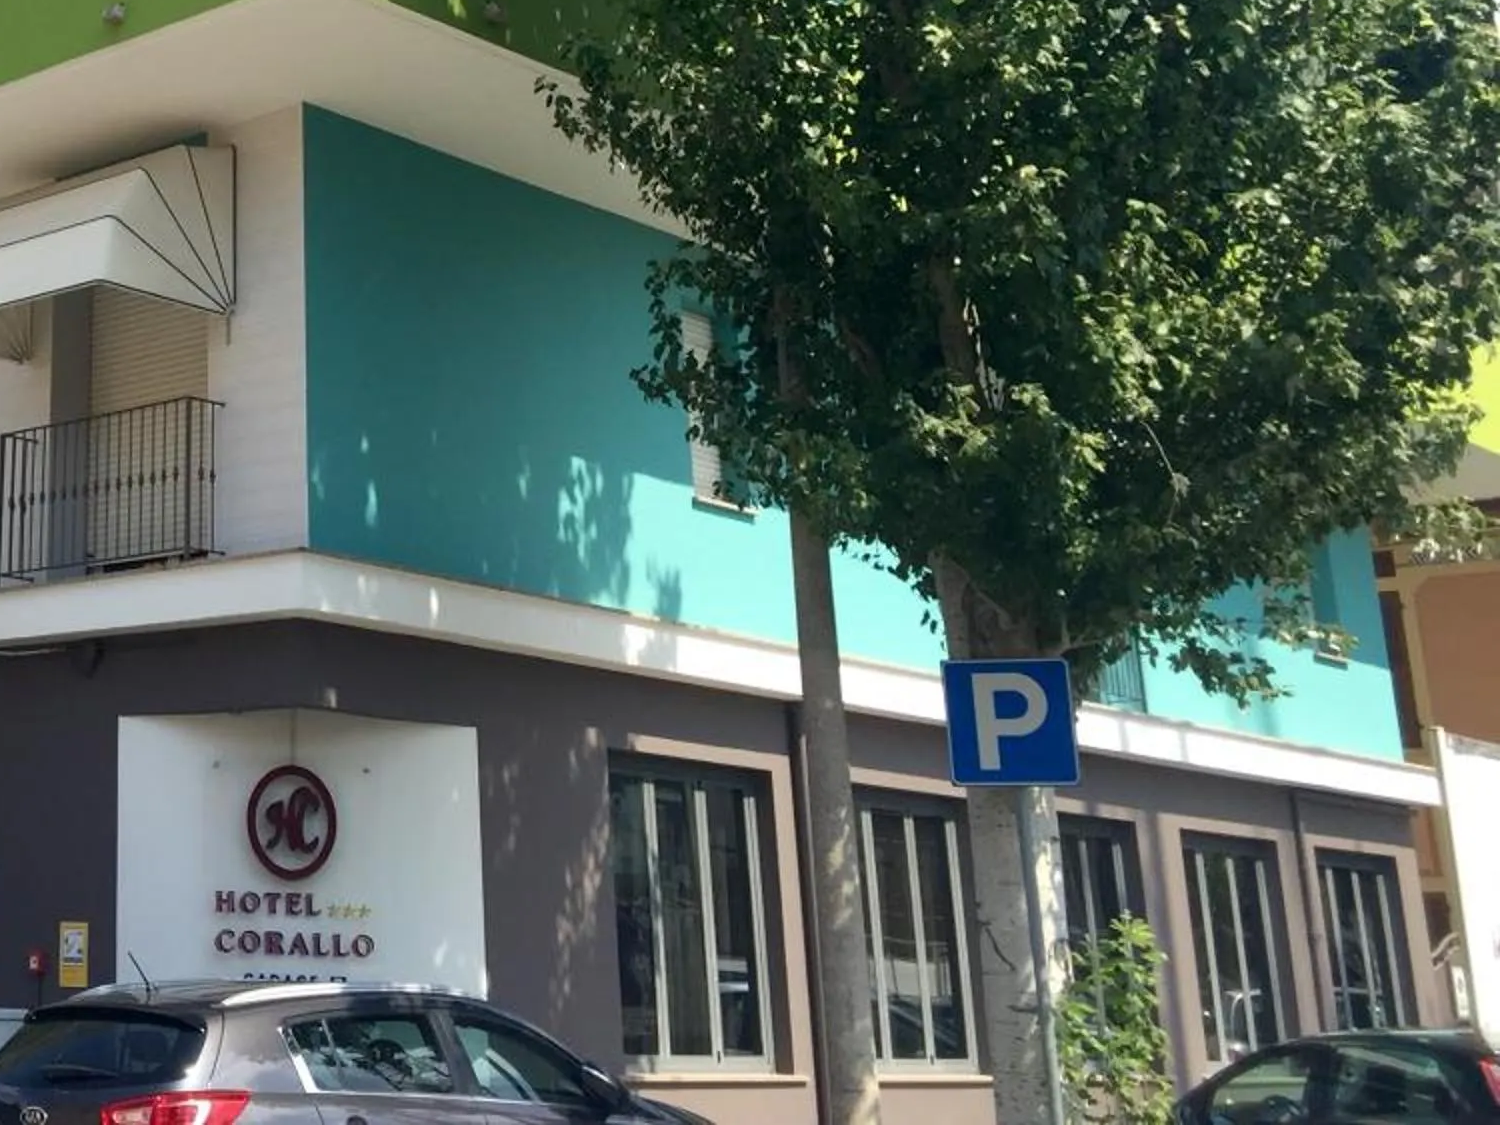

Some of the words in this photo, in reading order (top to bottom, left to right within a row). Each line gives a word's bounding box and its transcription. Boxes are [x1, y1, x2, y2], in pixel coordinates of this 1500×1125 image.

[971, 673, 1049, 771] P
[214, 890, 322, 917] HOTEL
[214, 928, 375, 958] CORALLO
